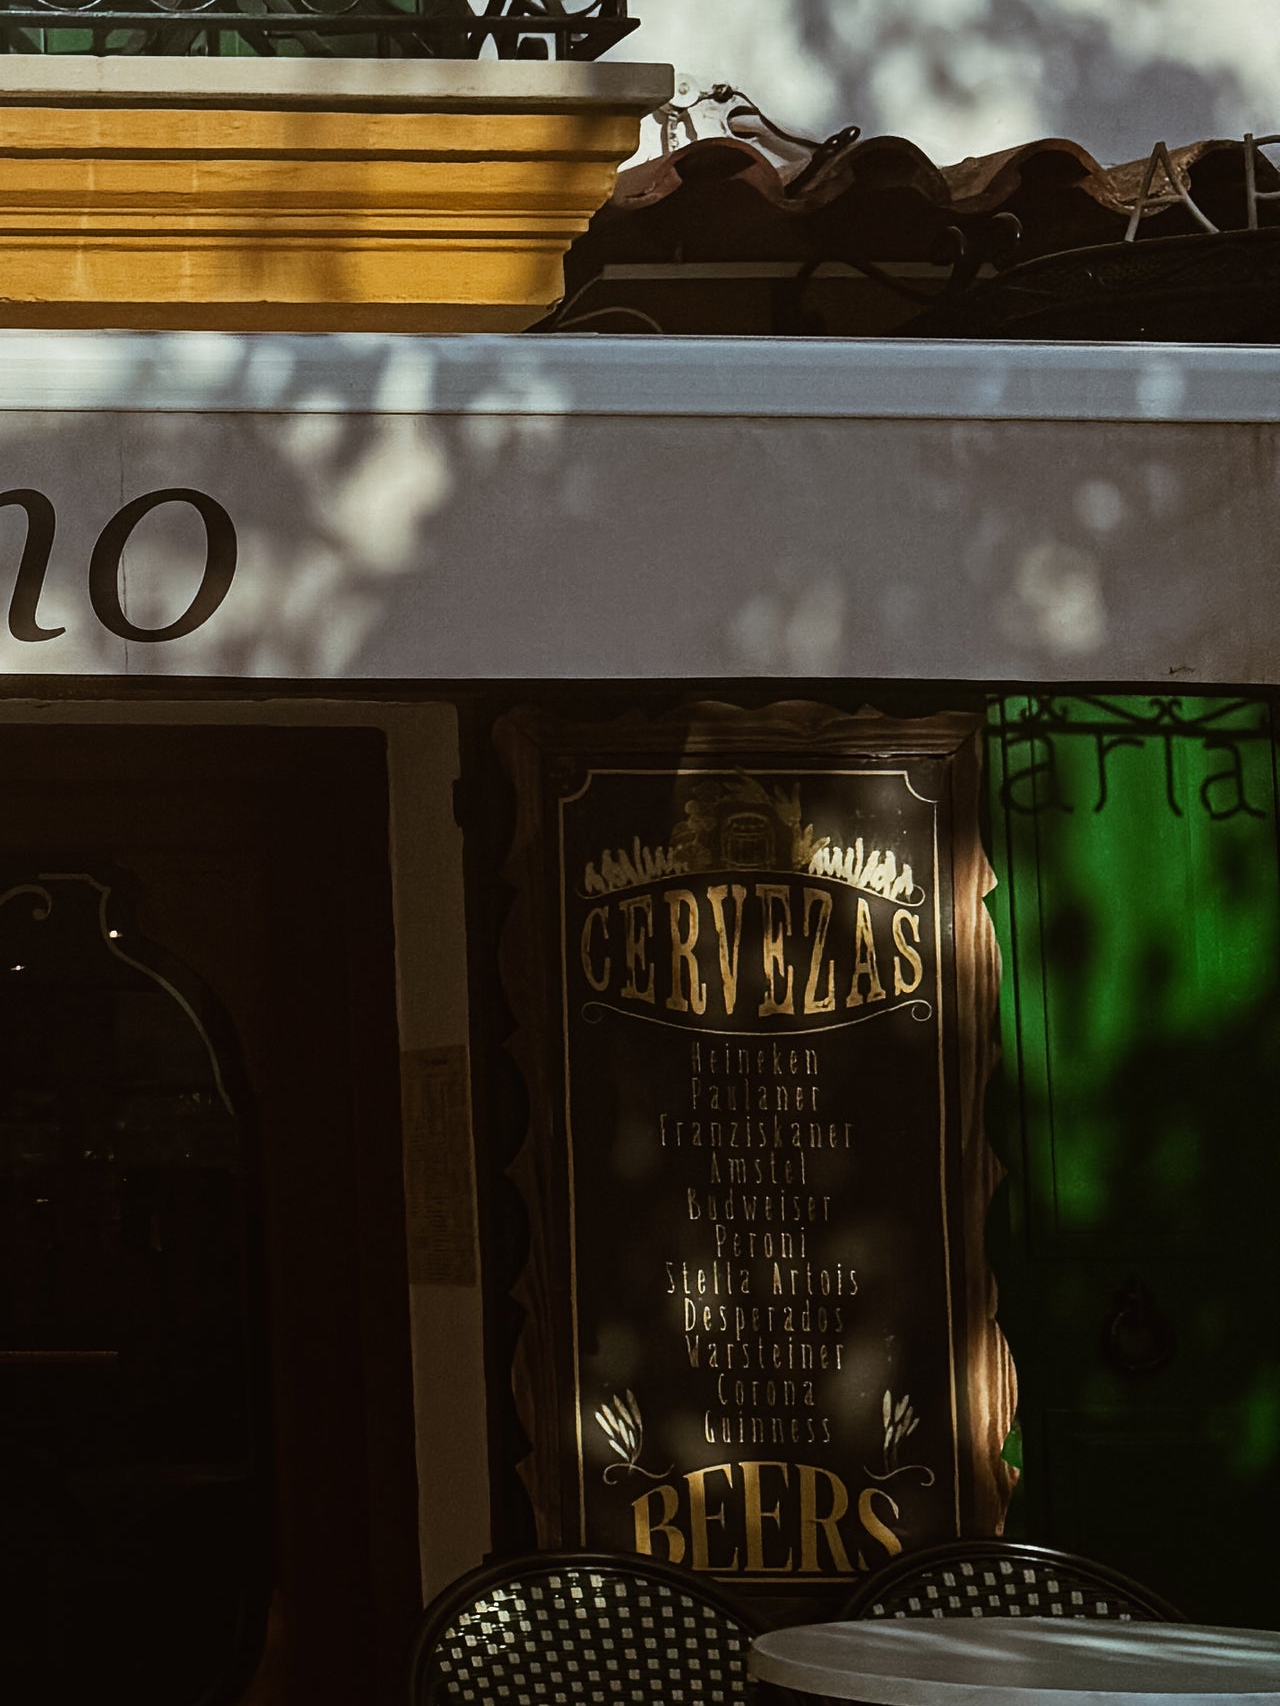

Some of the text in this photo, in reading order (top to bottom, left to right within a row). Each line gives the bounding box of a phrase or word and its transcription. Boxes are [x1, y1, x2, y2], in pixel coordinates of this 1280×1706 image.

[580, 882, 925, 1019] CERVEZAS
[712, 1150, 808, 1186] Amstel
[688, 1186, 830, 1223] Budweiser
[714, 1224, 809, 1260] Peroni
[667, 1261, 857, 1298] Stella Artois
[685, 1298, 841, 1341] Desperados
[685, 1336, 843, 1371] Warsteiner
[718, 1373, 814, 1408] Corona
[705, 1411, 830, 1443] Guinness
[630, 1460, 904, 1573] BEERS
